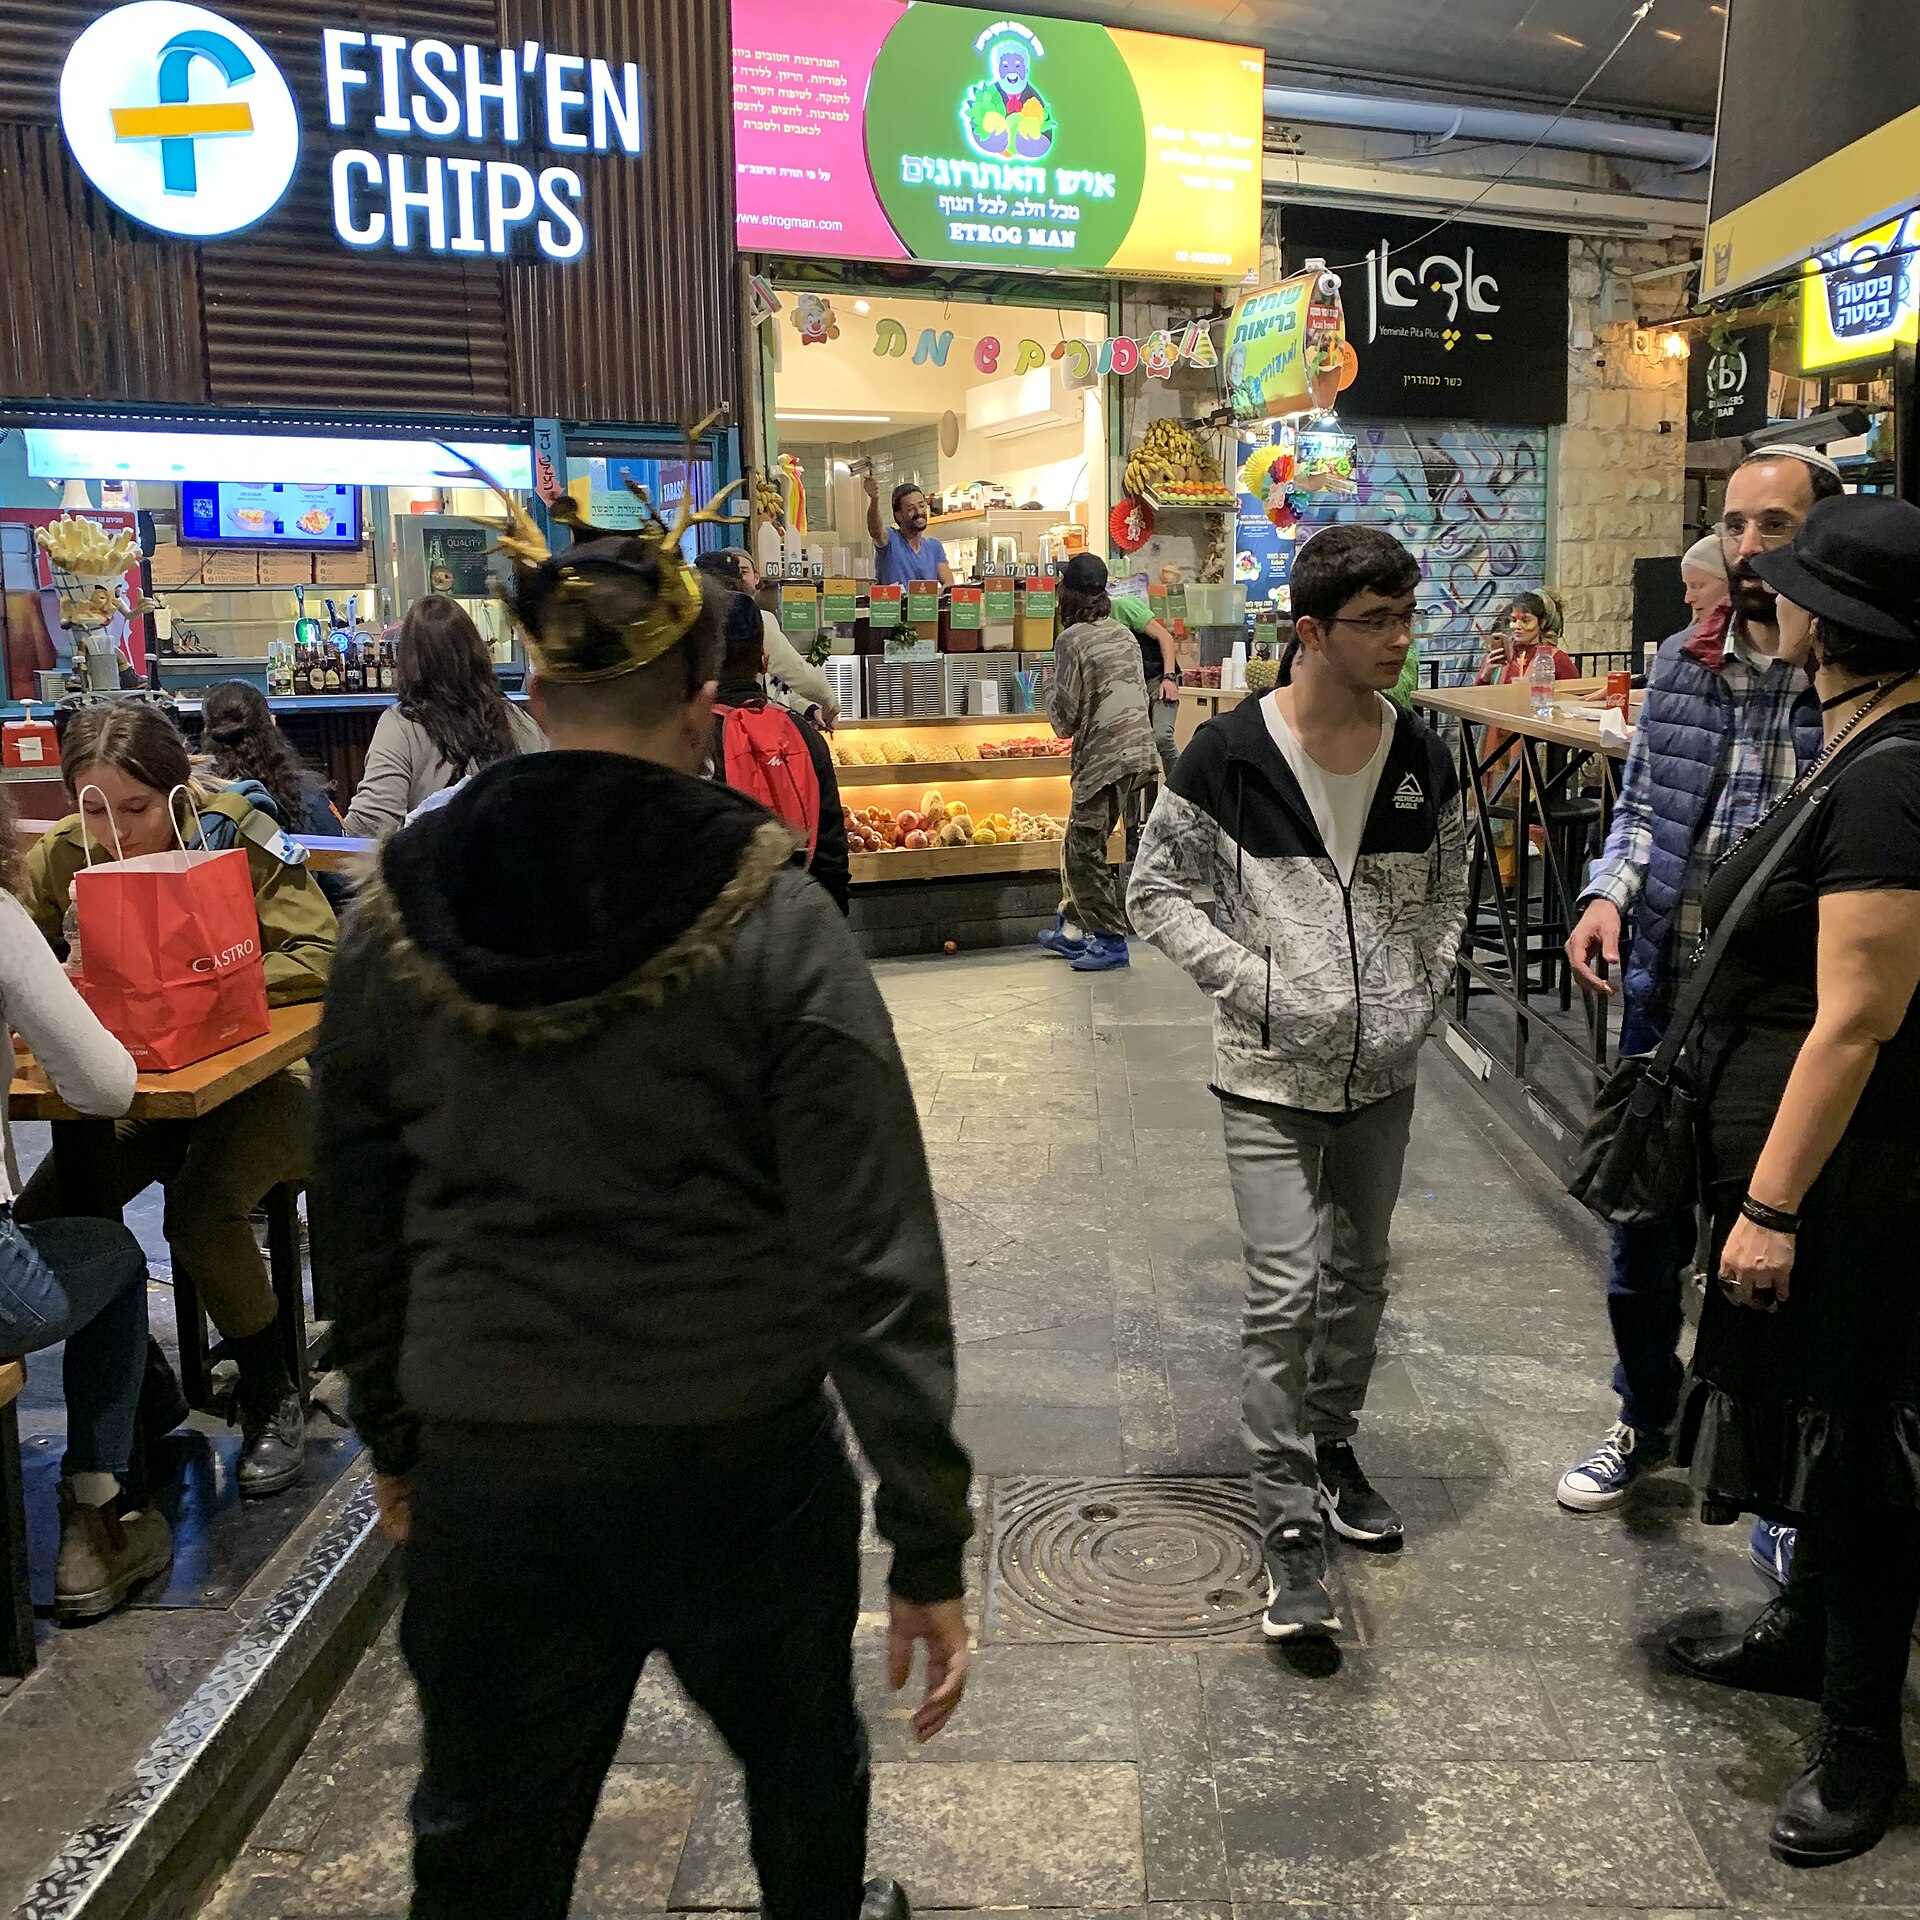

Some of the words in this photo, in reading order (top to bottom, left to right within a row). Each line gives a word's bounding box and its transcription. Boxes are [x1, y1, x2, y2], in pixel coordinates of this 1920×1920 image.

[754, 50, 790, 63] הטובים
[793, 55, 840, 69] הפתרונות
[740, 65, 772, 79] ללידה
[321, 27, 642, 155] FISH'EN
[750, 85, 775, 96] העור
[778, 88, 812, 100] לטיפוח
[743, 119, 781, 131] ולסכרת
[783, 123, 822, 136] לכאבים
[806, 169, 816, 180] פי
[817, 167, 831, 182] על
[902, 154, 1046, 194] האתרוגים
[1055, 167, 1116, 198] איש
[332, 148, 586, 259] CHIPS
[938, 194, 974, 216] הגוף
[977, 193, 1008, 215] לכל
[1049, 198, 1080, 220] מכל
[736, 212, 843, 231] ww.etrogman.com
[949, 222, 1023, 245] ETROG
[1028, 228, 1076, 248] MAN
[1837, 274, 1893, 306] פסטה
[1241, 284, 1304, 318] שותים
[1838, 298, 1891, 328] בסטה
[1232, 310, 1297, 345] בריאות
[1410, 326, 1424, 338] Pita
[1424, 328, 1440, 339] Plus
[1403, 375, 1441, 387] למהדרין
[1444, 376, 1463, 387] כשר
[1717, 407, 1735, 418] BAR
[535, 428, 551, 450] כאן
[663, 479, 686, 502] TABASC
[591, 505, 615, 513] הכשר
[447, 539, 481, 549] QUALITY
[767, 563, 779, 576] 60
[790, 563, 801, 576] 32
[812, 564, 823, 576] 17
[985, 563, 995, 575] 22
[1006, 564, 1015, 576] 17
[1026, 564, 1036, 576] 12
[1046, 564, 1054, 576] 6
[191, 938, 254, 973] CASTRO
